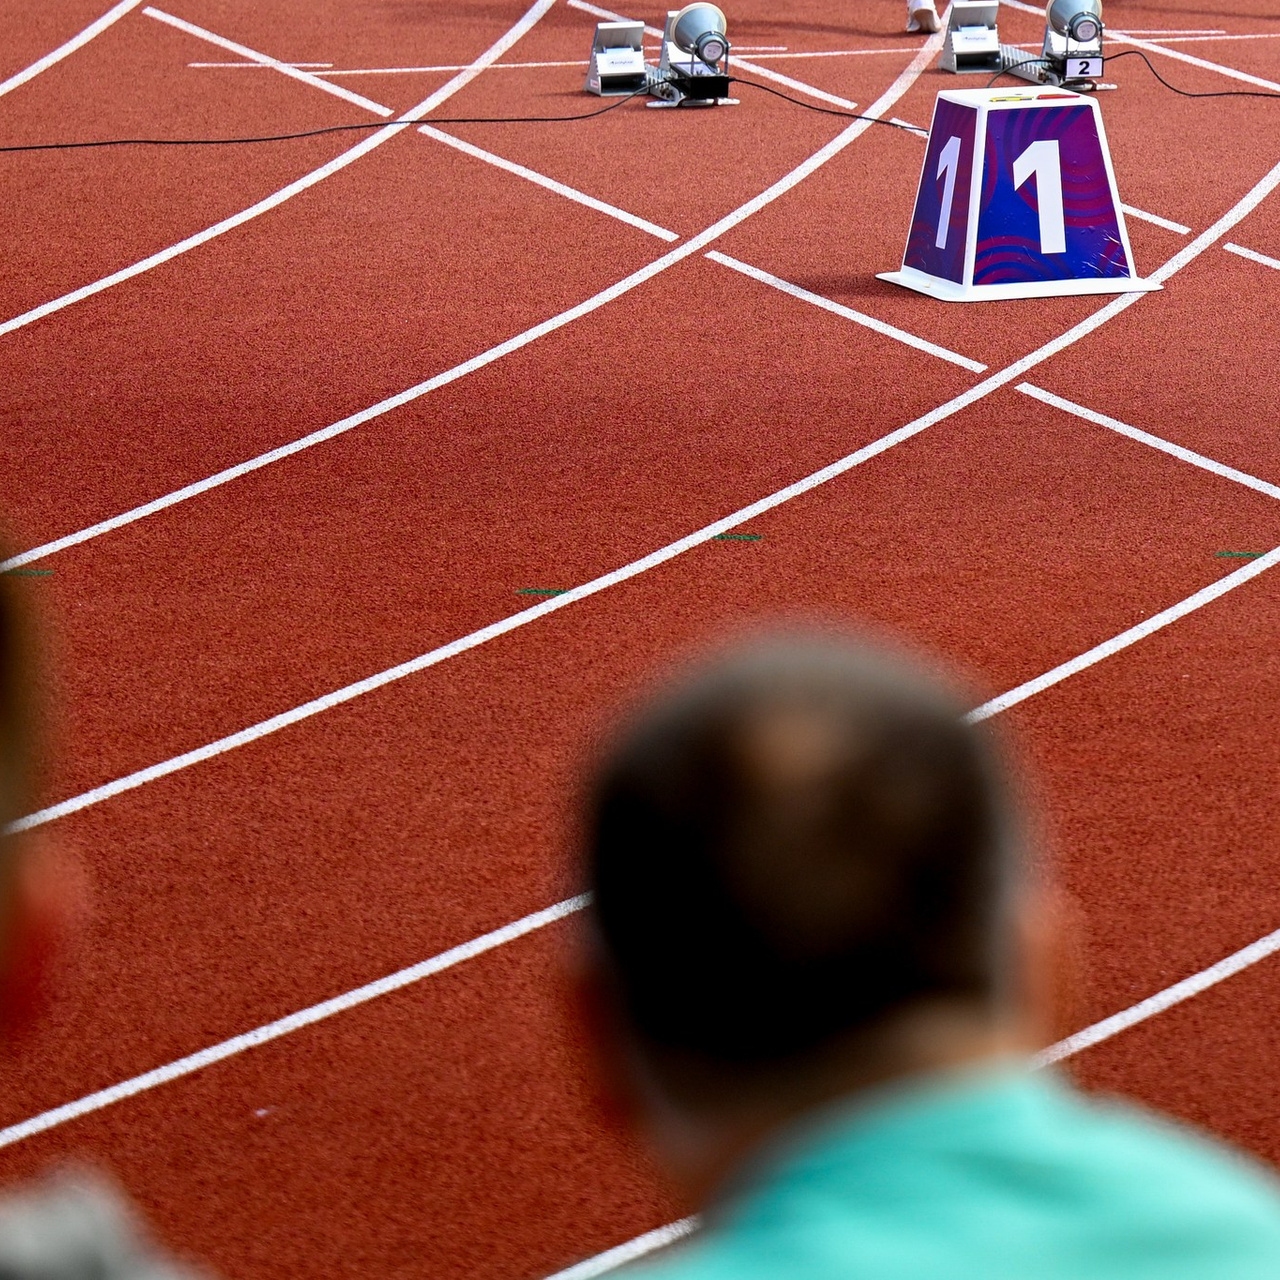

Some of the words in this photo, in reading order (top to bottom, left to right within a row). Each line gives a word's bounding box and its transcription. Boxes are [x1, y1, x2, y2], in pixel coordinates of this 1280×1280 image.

[1078, 60, 1090, 75] 2
[935, 135, 962, 250] 1
[1012, 140, 1067, 254] 1
